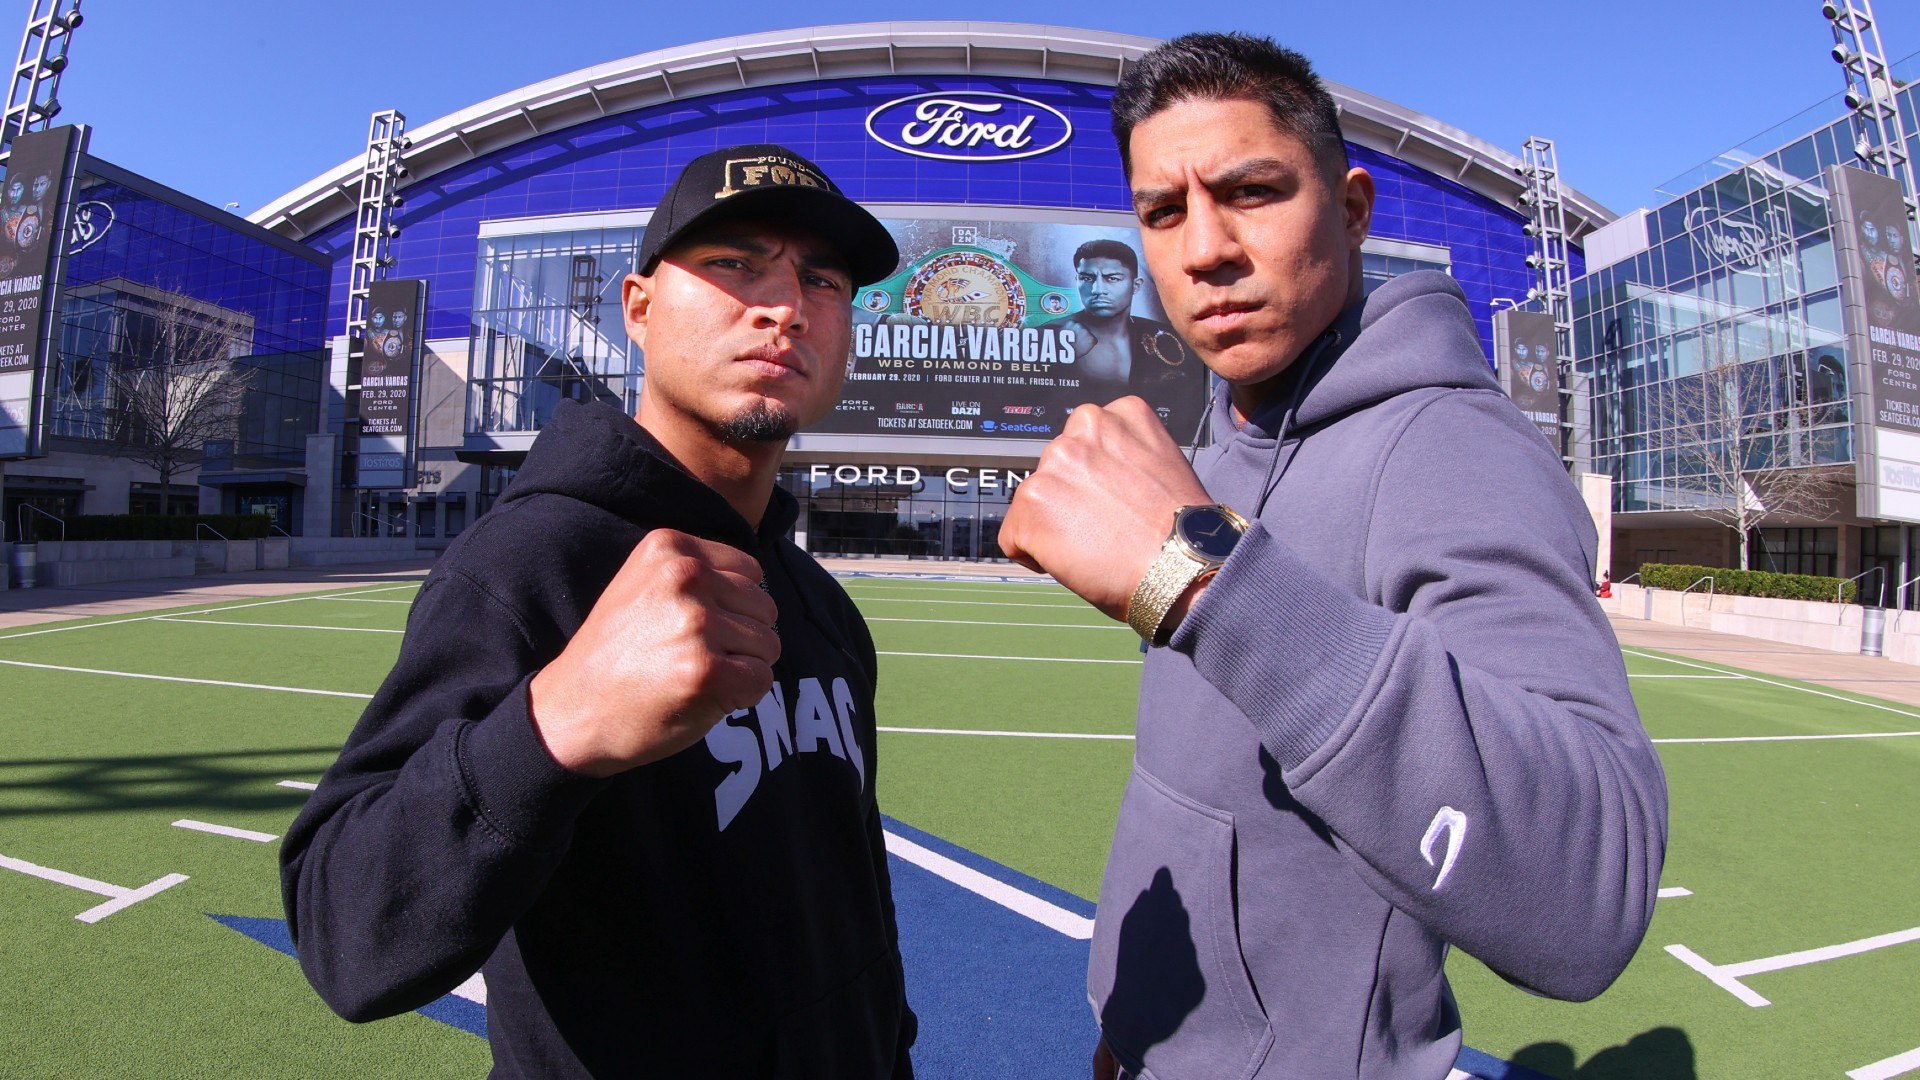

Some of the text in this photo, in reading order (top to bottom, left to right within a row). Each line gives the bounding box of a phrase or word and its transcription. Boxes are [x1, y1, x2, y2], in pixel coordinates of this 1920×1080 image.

[902, 100, 1035, 148] Ford
[757, 155, 806, 172] POUND
[14, 275, 42, 293] VARGAS
[923, 266, 1008, 303] DIAMOND CHAMPION
[3, 297, 38, 313] 29, 2020
[932, 305, 1001, 325] WBC
[1870, 325, 1897, 346] GARCIA
[15, 344, 24, 354] AT
[855, 323, 958, 359] GARCIA
[967, 324, 1076, 364] VARGAS
[1872, 349, 1891, 364] FEB.
[878, 359, 1051, 373] WBC DIAMOND BELT
[362, 375, 409, 387] GARCIA VARGAS
[849, 373, 887, 381] FEBRUARY
[903, 374, 921, 382] 2020
[934, 374, 953, 383] FORD
[955, 375, 980, 384] CENTER
[982, 376, 991, 384] AT
[993, 376, 1005, 385] THE
[1059, 379, 1080, 388] TEXAS
[1888, 369, 1911, 380] FORD
[1882, 377, 1918, 391] CENTER
[362, 390, 376, 399] FEB.
[389, 389, 407, 398] 2020
[951, 407, 981, 416] DAZN
[1885, 399, 1920, 416] TICKETS AT
[368, 417, 398, 426] TICKETS AT
[878, 417, 973, 431] TICKETS AT SEATGEEK.COM
[1534, 411, 1558, 424] VARGAS
[362, 425, 403, 433] SEATGEEK.COM
[1000, 422, 1051, 433] SeatGeek
[810, 464, 921, 485] FORD
[704, 676, 866, 833] SNAC
